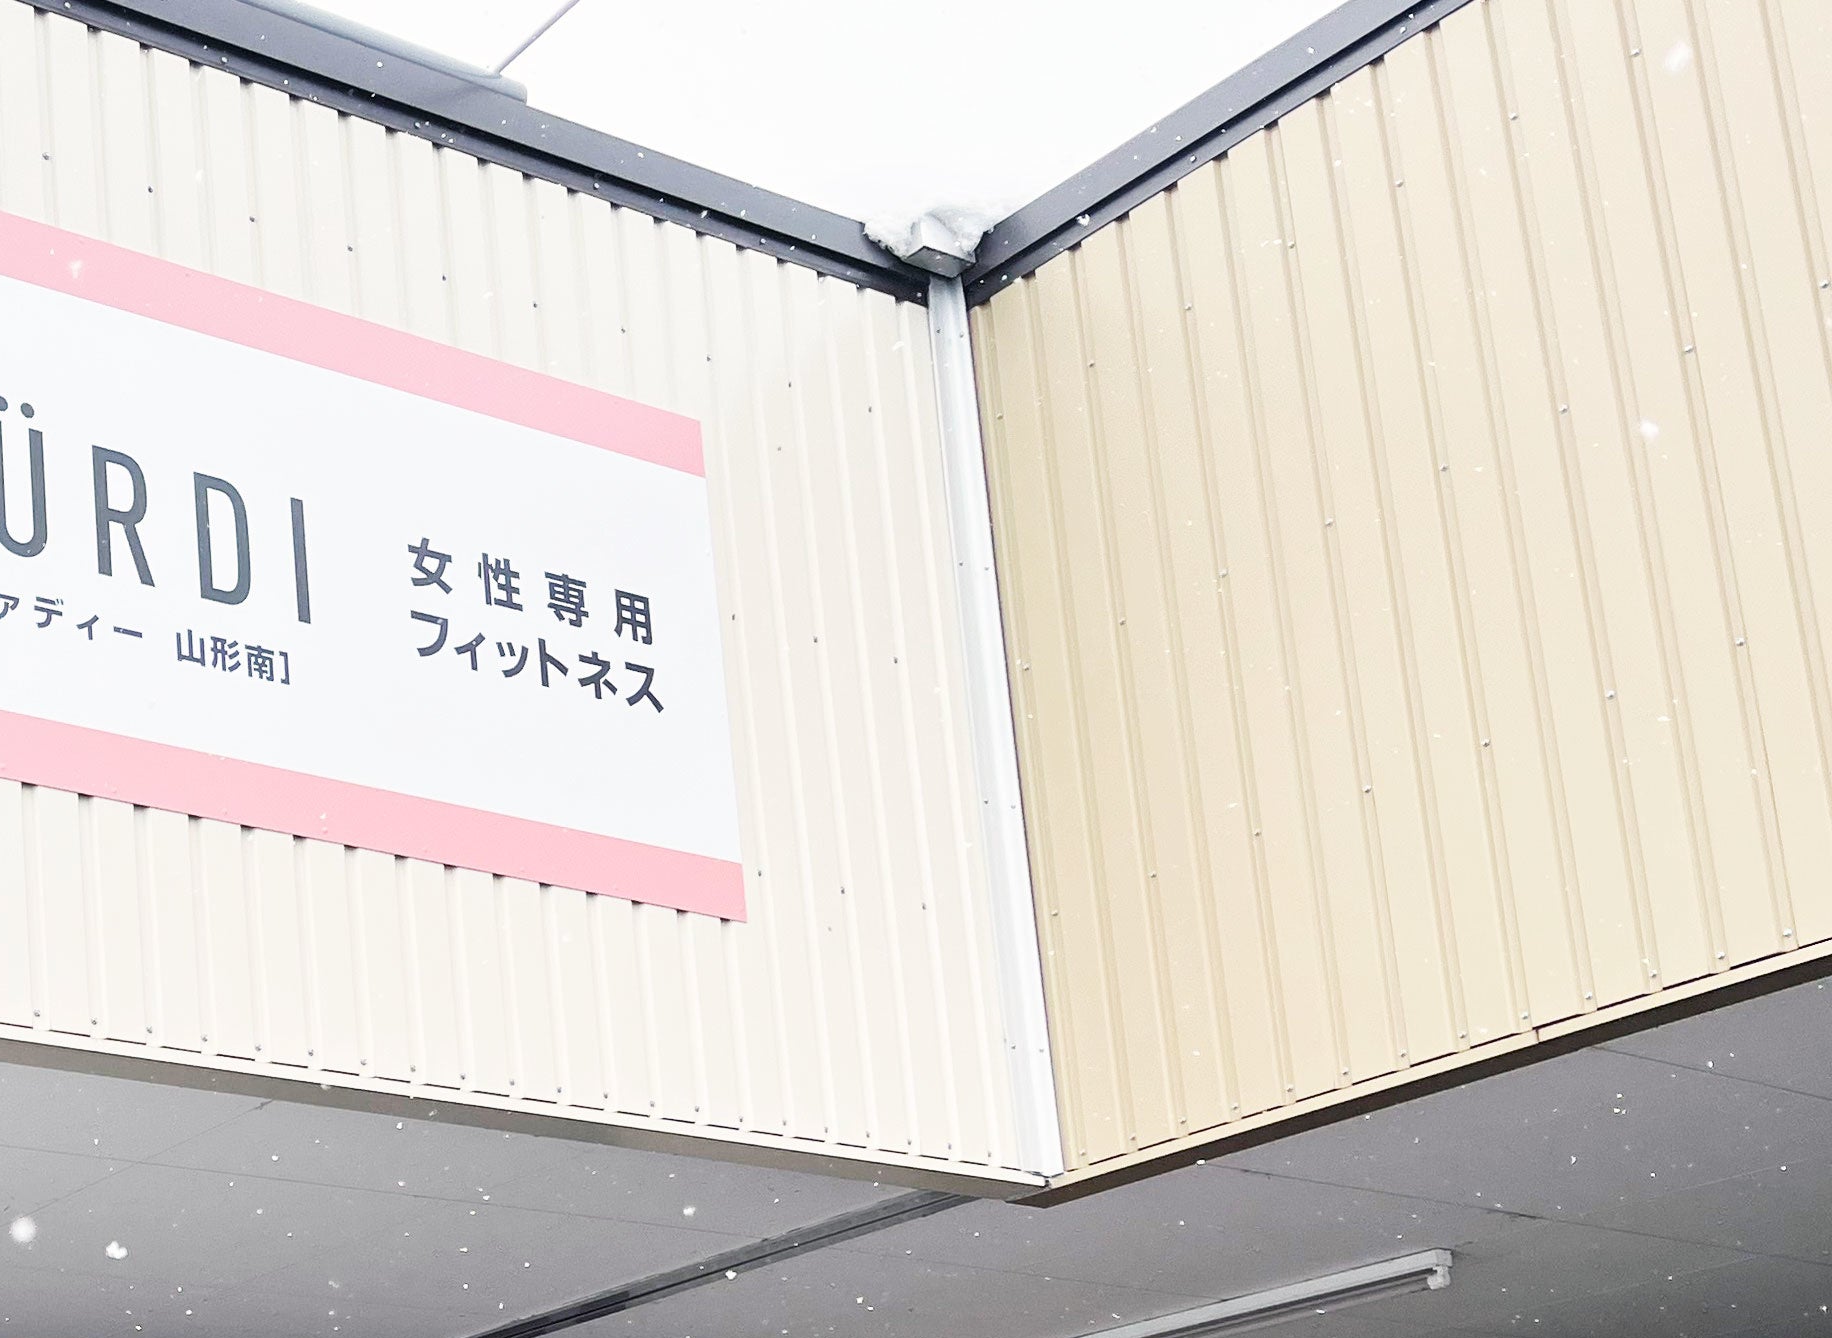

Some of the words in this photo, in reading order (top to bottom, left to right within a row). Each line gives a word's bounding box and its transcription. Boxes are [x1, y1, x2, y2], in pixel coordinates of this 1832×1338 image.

[407, 537, 653, 645] 女性専用
[410, 610, 665, 713] フィットネス
